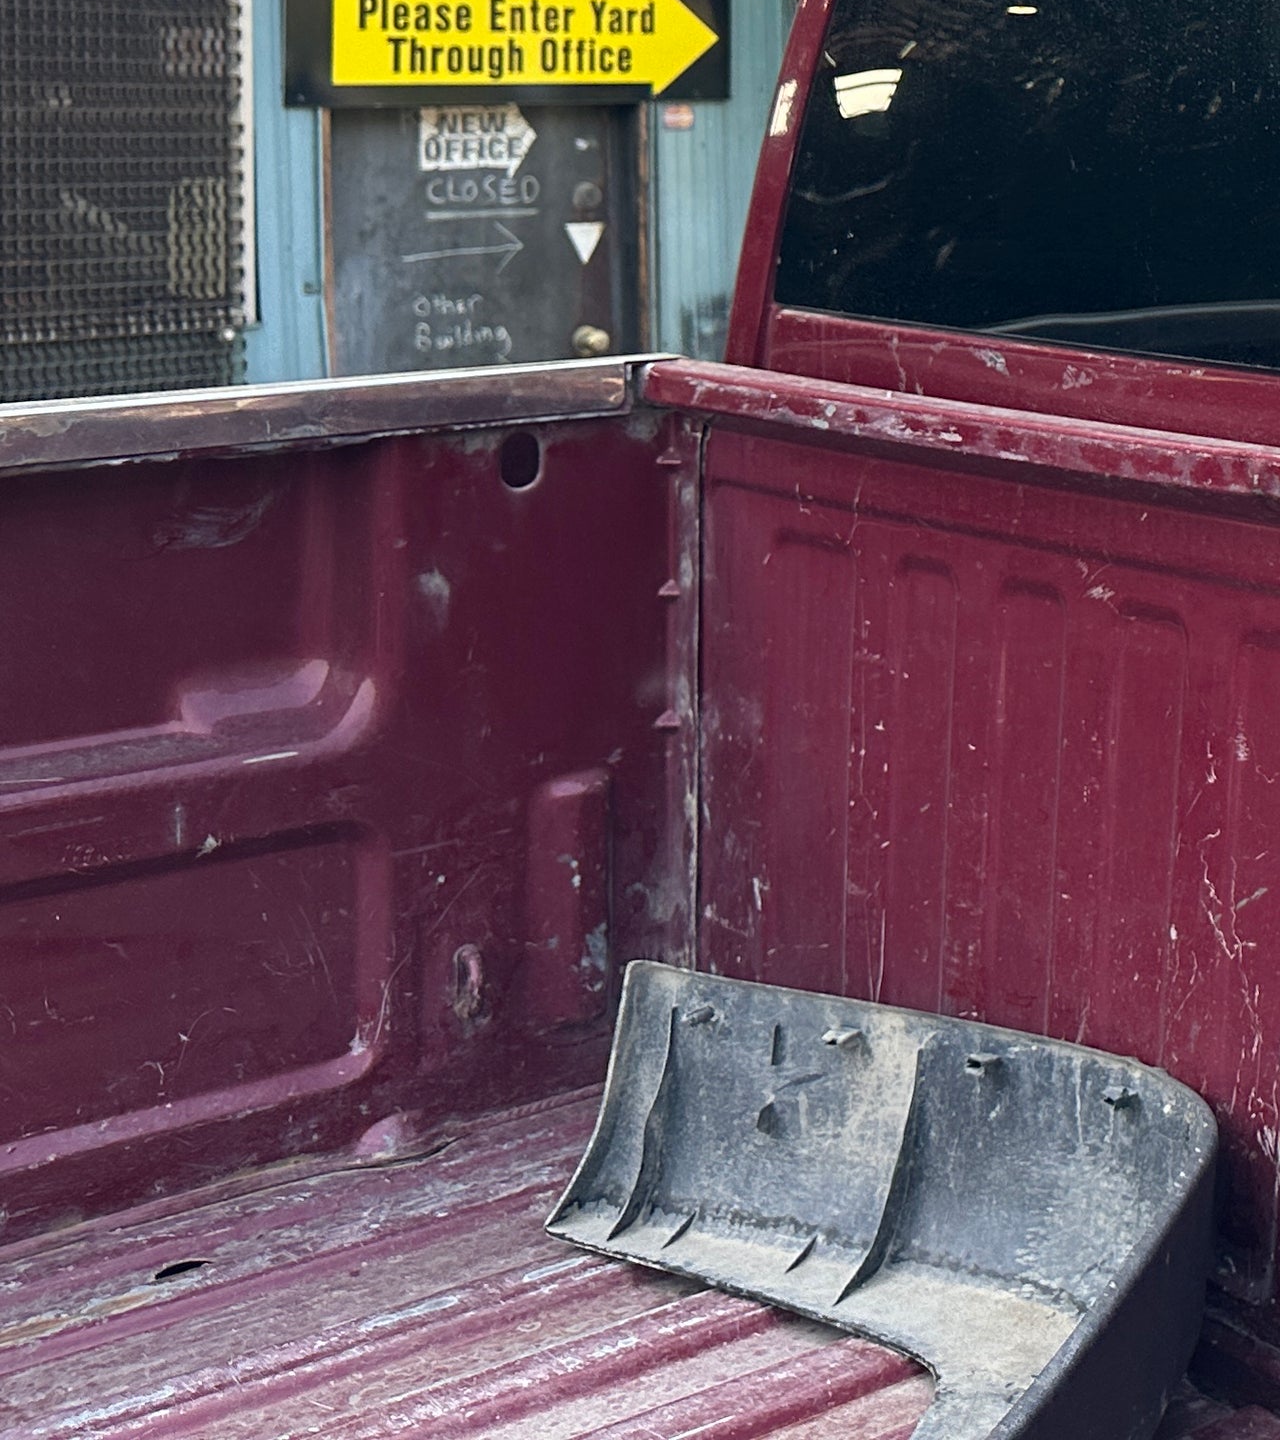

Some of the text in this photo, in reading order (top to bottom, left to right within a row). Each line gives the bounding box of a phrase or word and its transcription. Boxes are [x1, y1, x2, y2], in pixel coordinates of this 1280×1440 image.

[589, 0, 656, 35] Yard
[387, 38, 633, 78] Through Office
[438, 111, 506, 134] NEW
[424, 137, 524, 161] OFFICE
[426, 174, 540, 205] CLOSED
